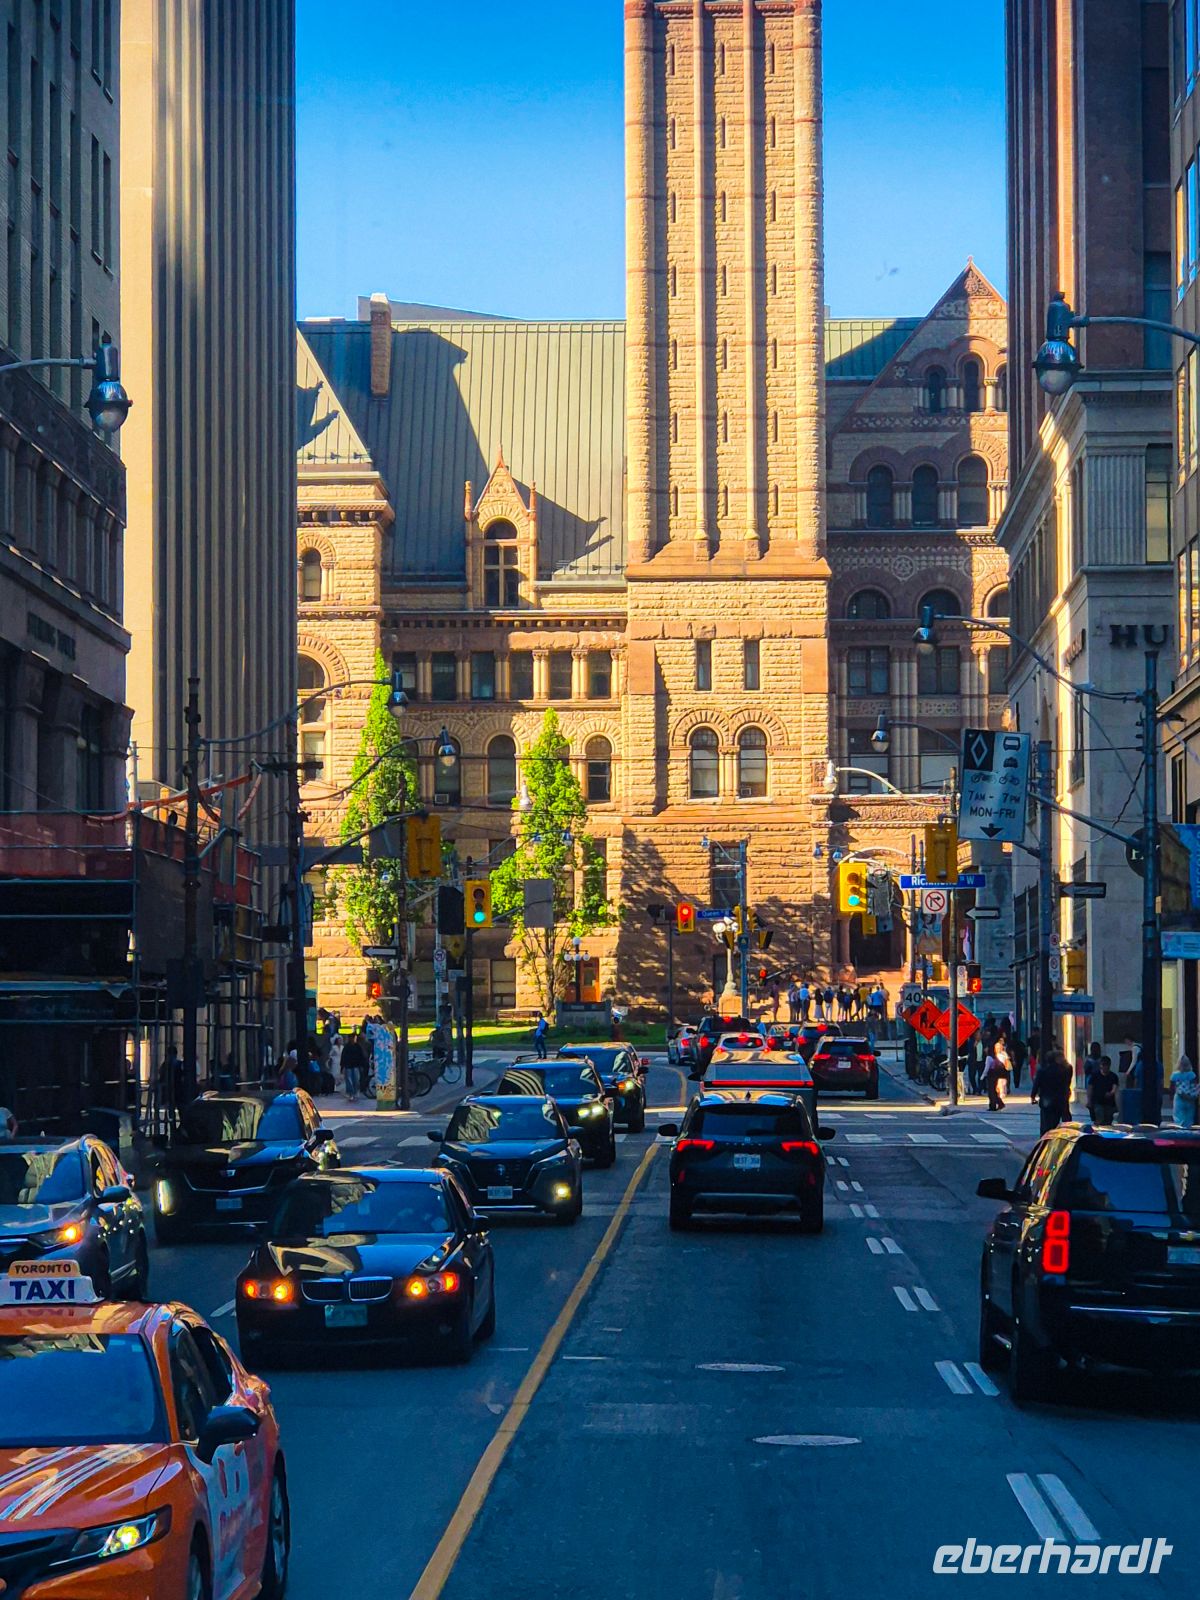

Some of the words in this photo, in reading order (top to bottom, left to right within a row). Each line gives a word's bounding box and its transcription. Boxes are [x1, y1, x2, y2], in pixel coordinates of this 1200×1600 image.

[970, 807, 1016, 818] MON-FRI
[966, 876, 975, 885] W
[972, 980, 978, 991] 2
[906, 992, 921, 1003] 40
[15, 1263, 71, 1274] TORONTO
[10, 1280, 75, 1300] TAXI
